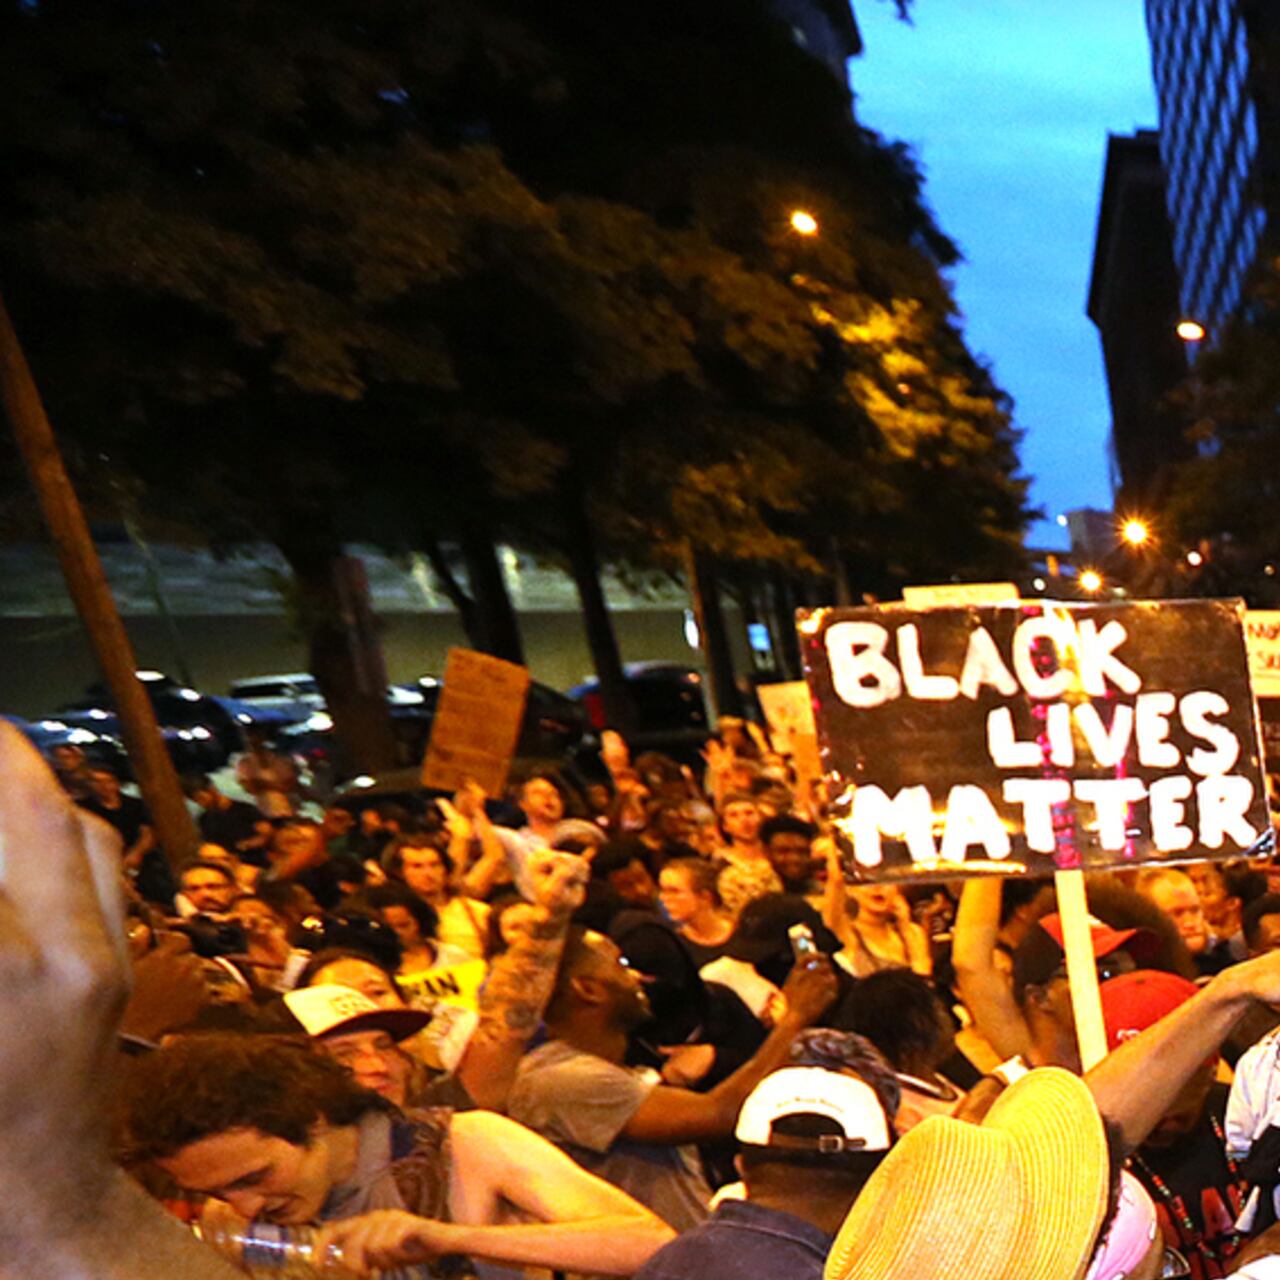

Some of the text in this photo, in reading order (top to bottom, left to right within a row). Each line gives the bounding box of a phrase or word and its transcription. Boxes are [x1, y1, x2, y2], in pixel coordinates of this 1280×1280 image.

[823, 616, 1143, 709] BLACK
[986, 690, 1241, 777] LIVES
[850, 772, 1259, 869] MATTER
